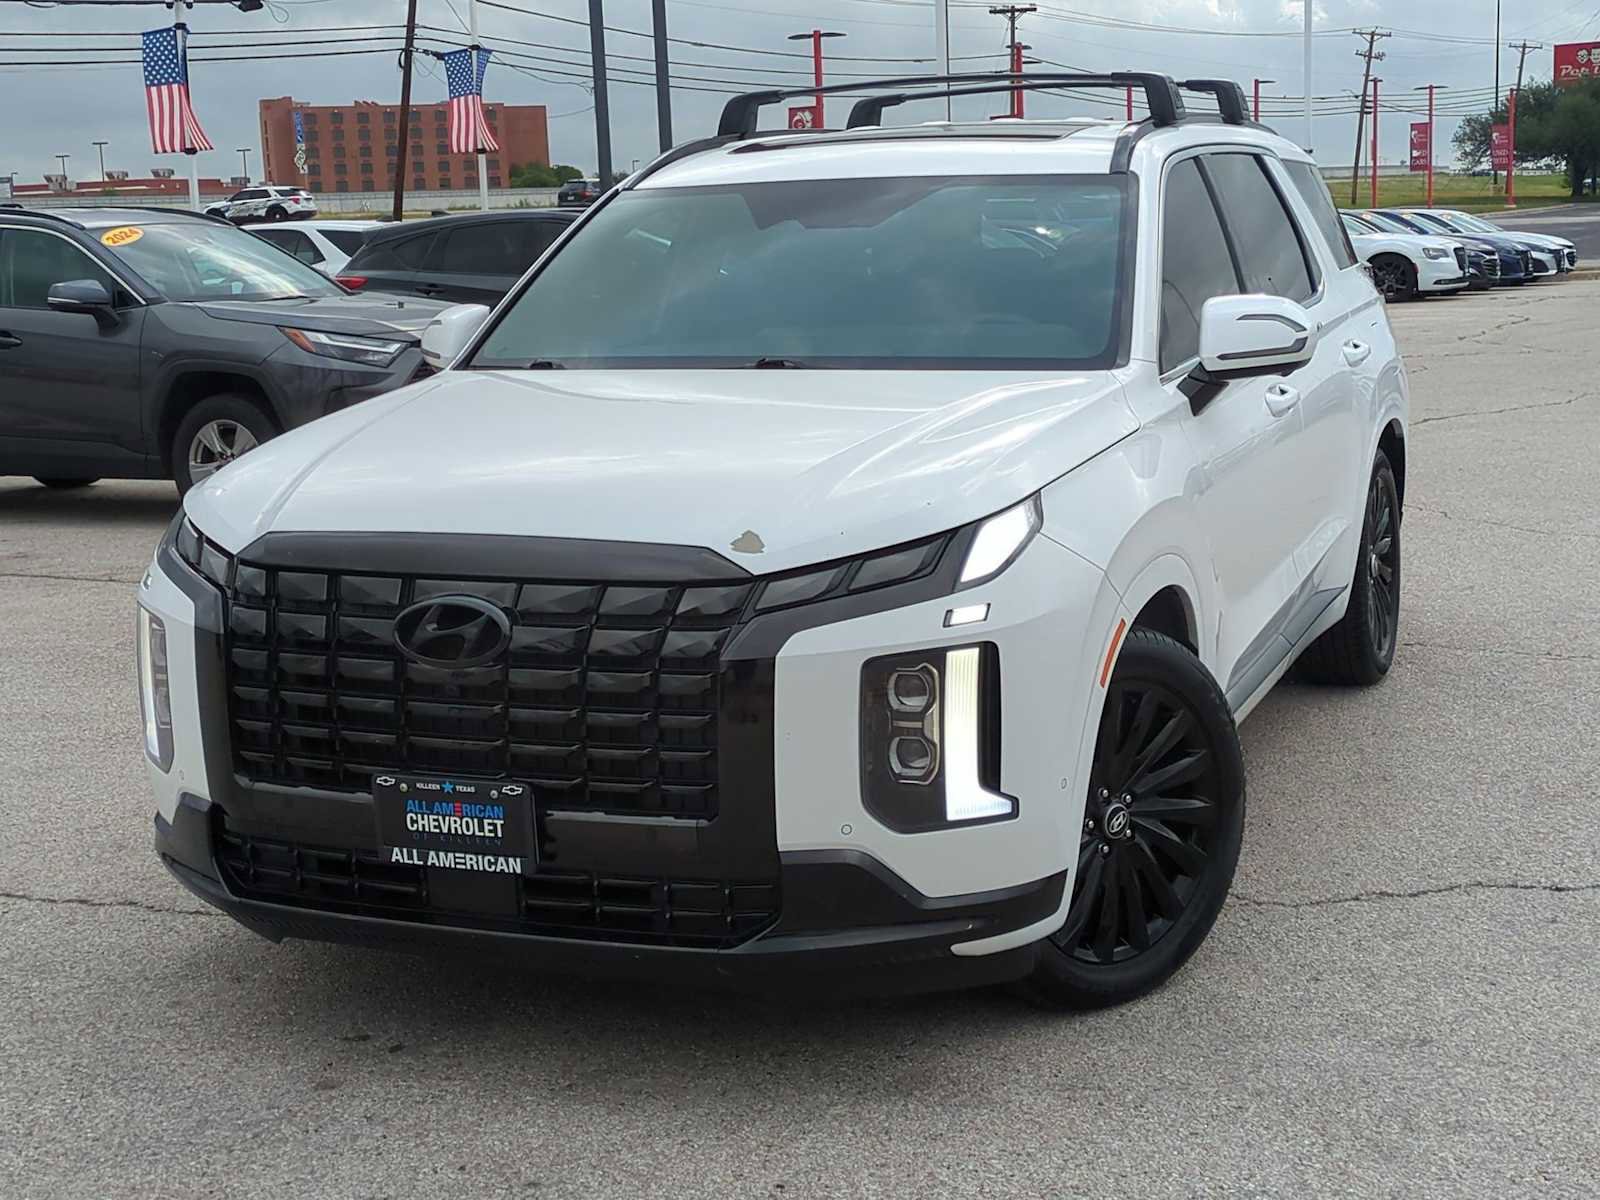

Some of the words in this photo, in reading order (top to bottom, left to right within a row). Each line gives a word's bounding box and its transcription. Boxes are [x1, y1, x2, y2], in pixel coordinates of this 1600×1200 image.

[105, 228, 139, 244] 2024
[416, 782, 440, 790] KILLEEN
[455, 785, 475, 793] TEXAS
[406, 800, 430, 813] ALL
[433, 801, 504, 819] AMERICAN
[406, 813, 504, 837] CHEVROLET
[391, 847, 423, 865] ALL
[427, 850, 521, 874] AMERICAN
